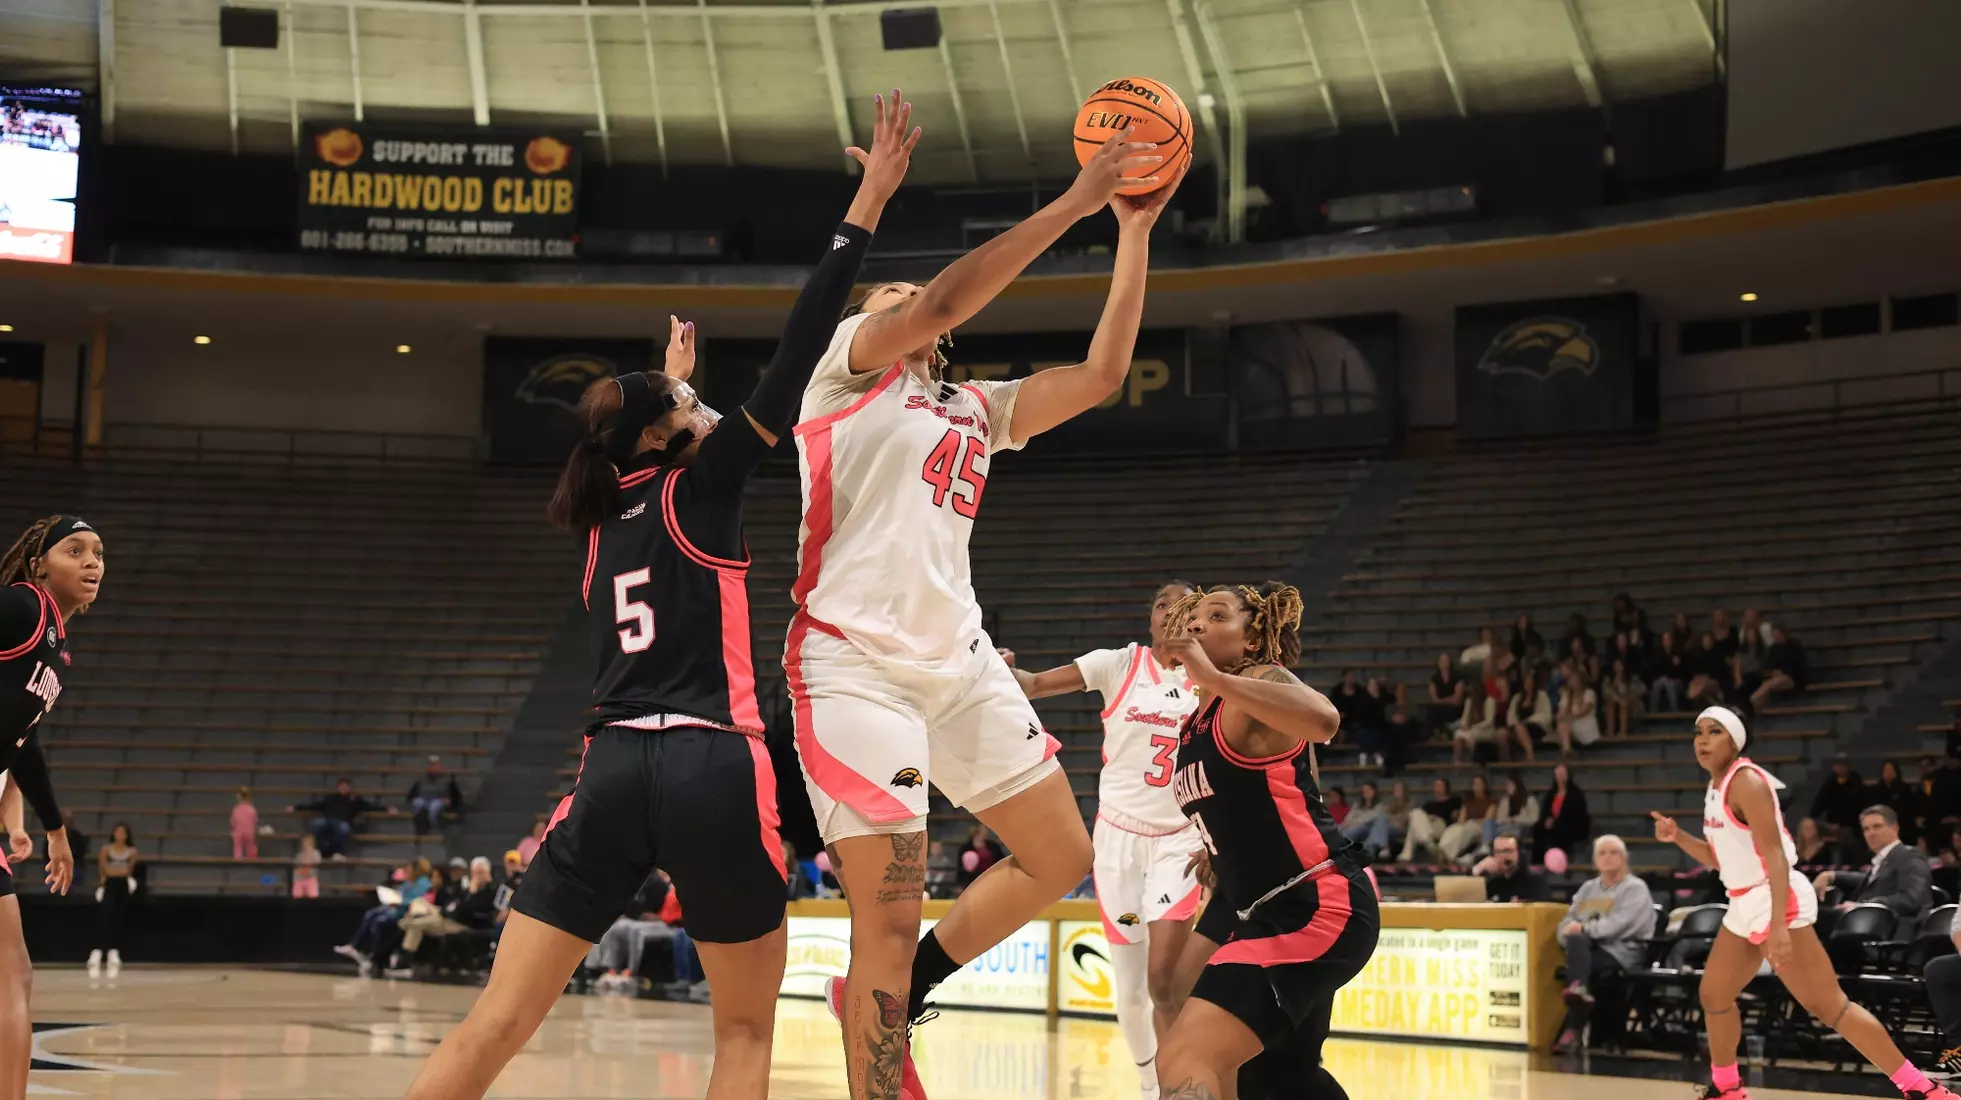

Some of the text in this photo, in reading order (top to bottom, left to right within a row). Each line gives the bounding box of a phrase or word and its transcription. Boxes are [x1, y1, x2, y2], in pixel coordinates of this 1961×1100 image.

[1090, 79, 1162, 106] ilson
[372, 140, 515, 166] SUPPORT THE
[308, 169, 574, 214] HARDWOOD CLUB
[426, 219, 457, 234] CALL
[479, 221, 514, 235] VISIT
[921, 428, 986, 520] 45
[614, 566, 656, 654] 5
[1124, 706, 1178, 729] Southern
[1144, 733, 1179, 787] 3
[1489, 942, 1508, 959] GET
[1358, 955, 1480, 988] HERN MISS
[1489, 962, 1521, 979] TODAY
[1331, 989, 1480, 1035] MEDAY APP
